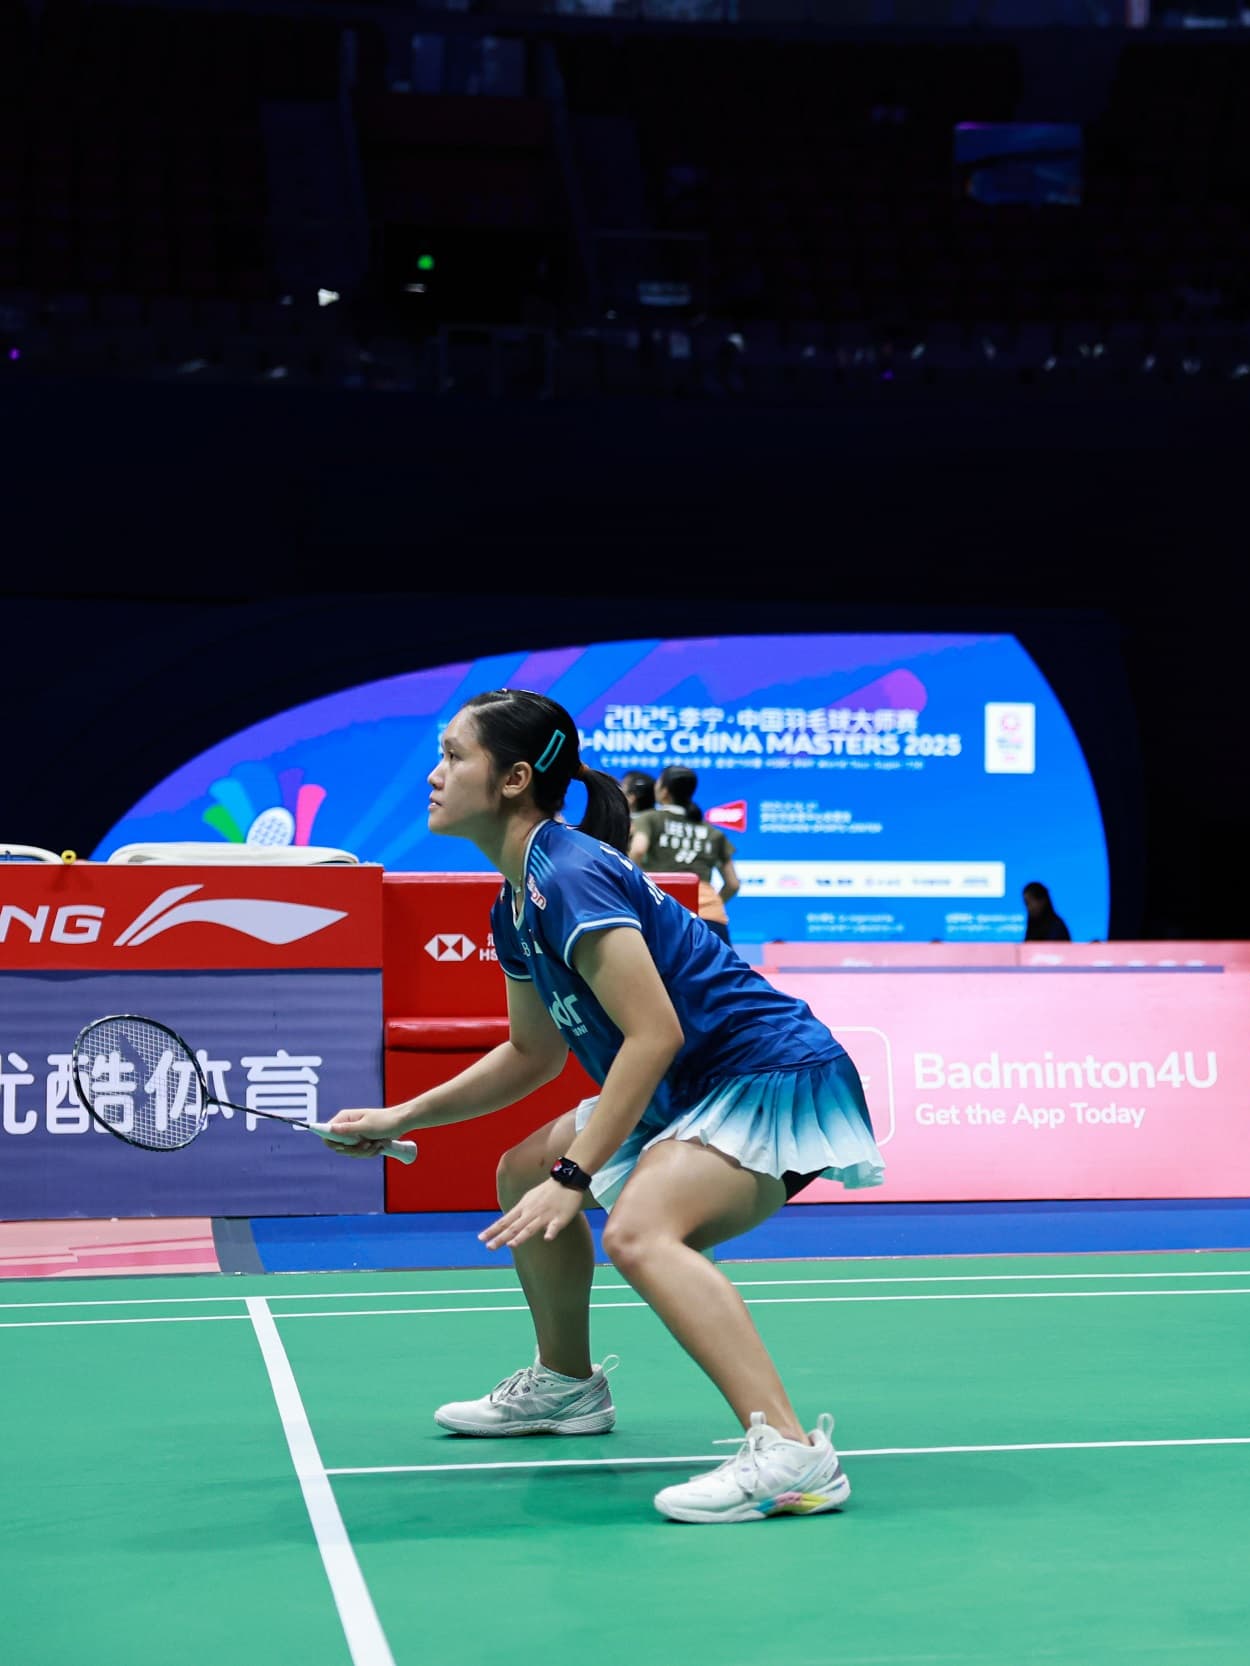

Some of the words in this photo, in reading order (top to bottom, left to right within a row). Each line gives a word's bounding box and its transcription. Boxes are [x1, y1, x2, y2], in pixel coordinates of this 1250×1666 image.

[578, 729, 665, 754] I-NING
[671, 730, 762, 755] CHINA
[767, 732, 898, 757] MASTERS
[904, 734, 962, 757] 2025
[0, 904, 105, 944] NG
[914, 1051, 1218, 1090] Badminton4U
[915, 1104, 960, 1126] Get
[967, 1103, 1006, 1125] the
[1013, 1104, 1065, 1128] App
[1071, 1103, 1145, 1128] Today
